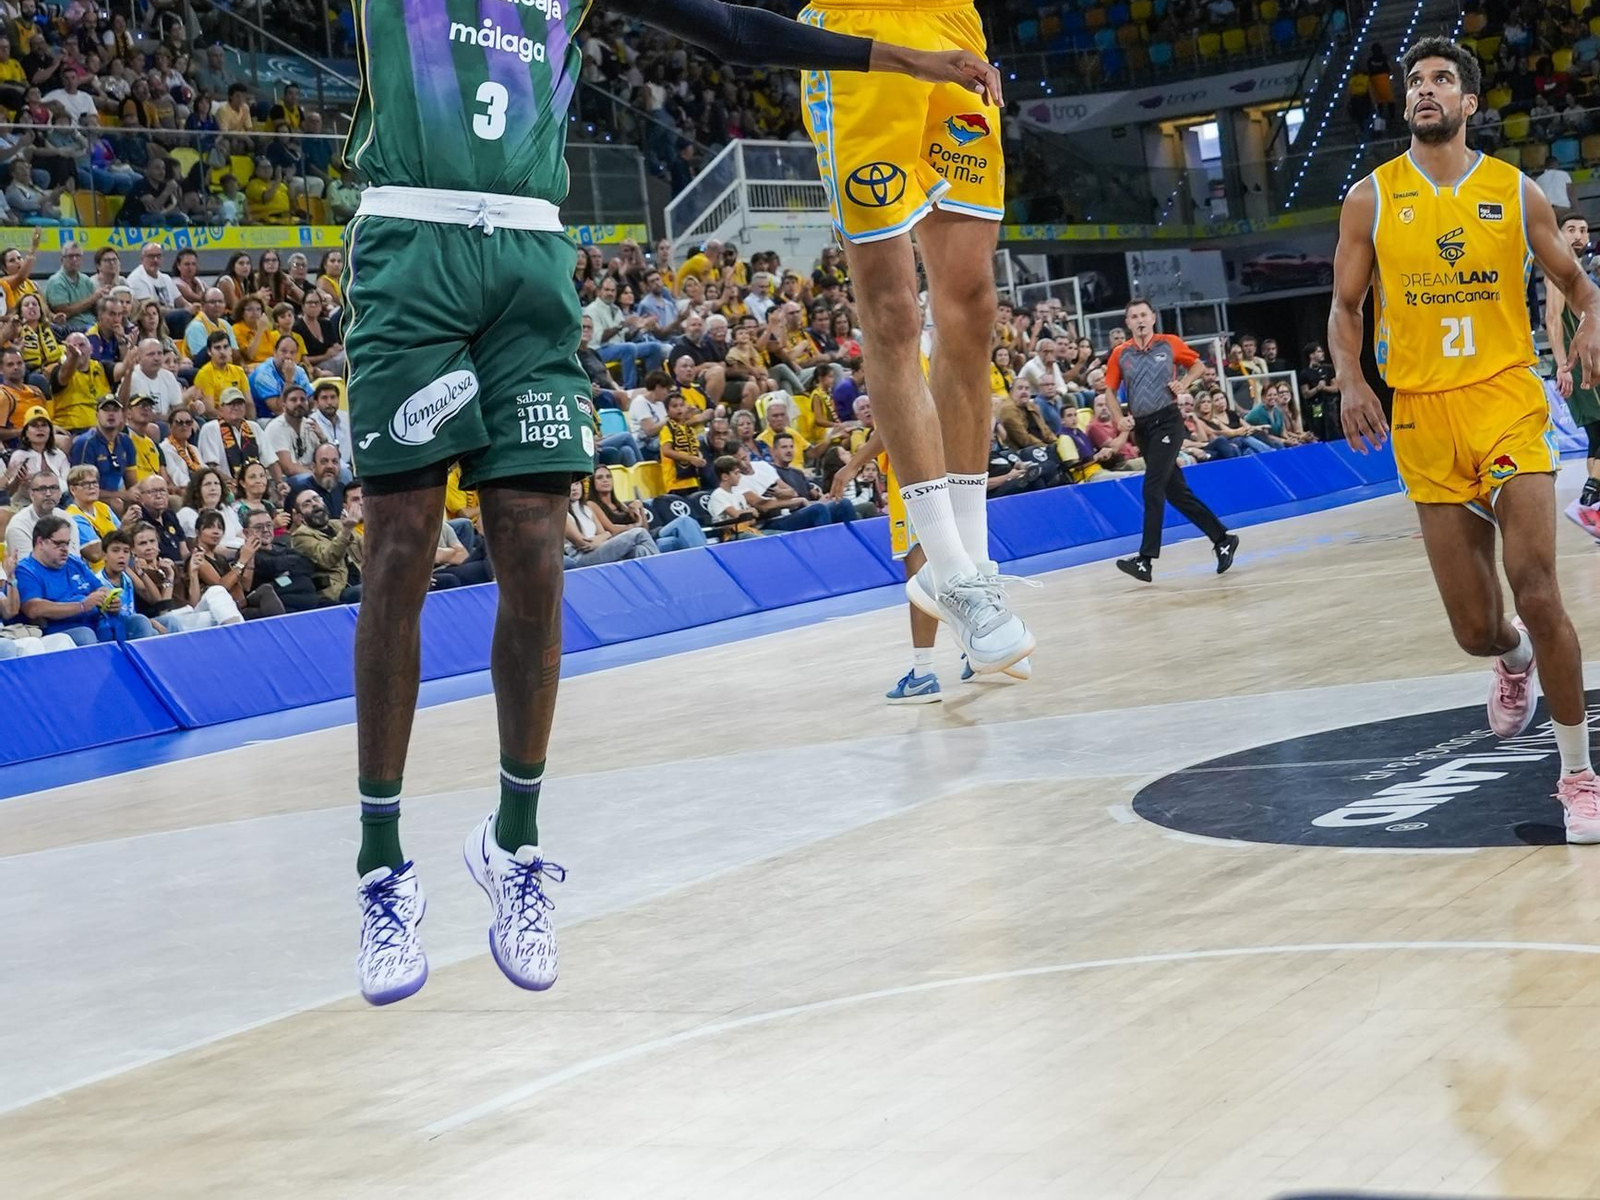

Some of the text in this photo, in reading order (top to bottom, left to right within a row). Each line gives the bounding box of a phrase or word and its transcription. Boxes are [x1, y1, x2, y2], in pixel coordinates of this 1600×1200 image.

[473, 81, 508, 140] 3
[1052, 102, 1087, 121] trop
[929, 142, 987, 169] Poema
[954, 165, 984, 185] Mar
[1400, 271, 1498, 288] DREAMLAND
[1440, 316, 1476, 358] 21
[401, 376, 473, 439] famadesa
[516, 389, 552, 405] sabor
[517, 397, 571, 423] a má
[519, 419, 573, 449] laga
